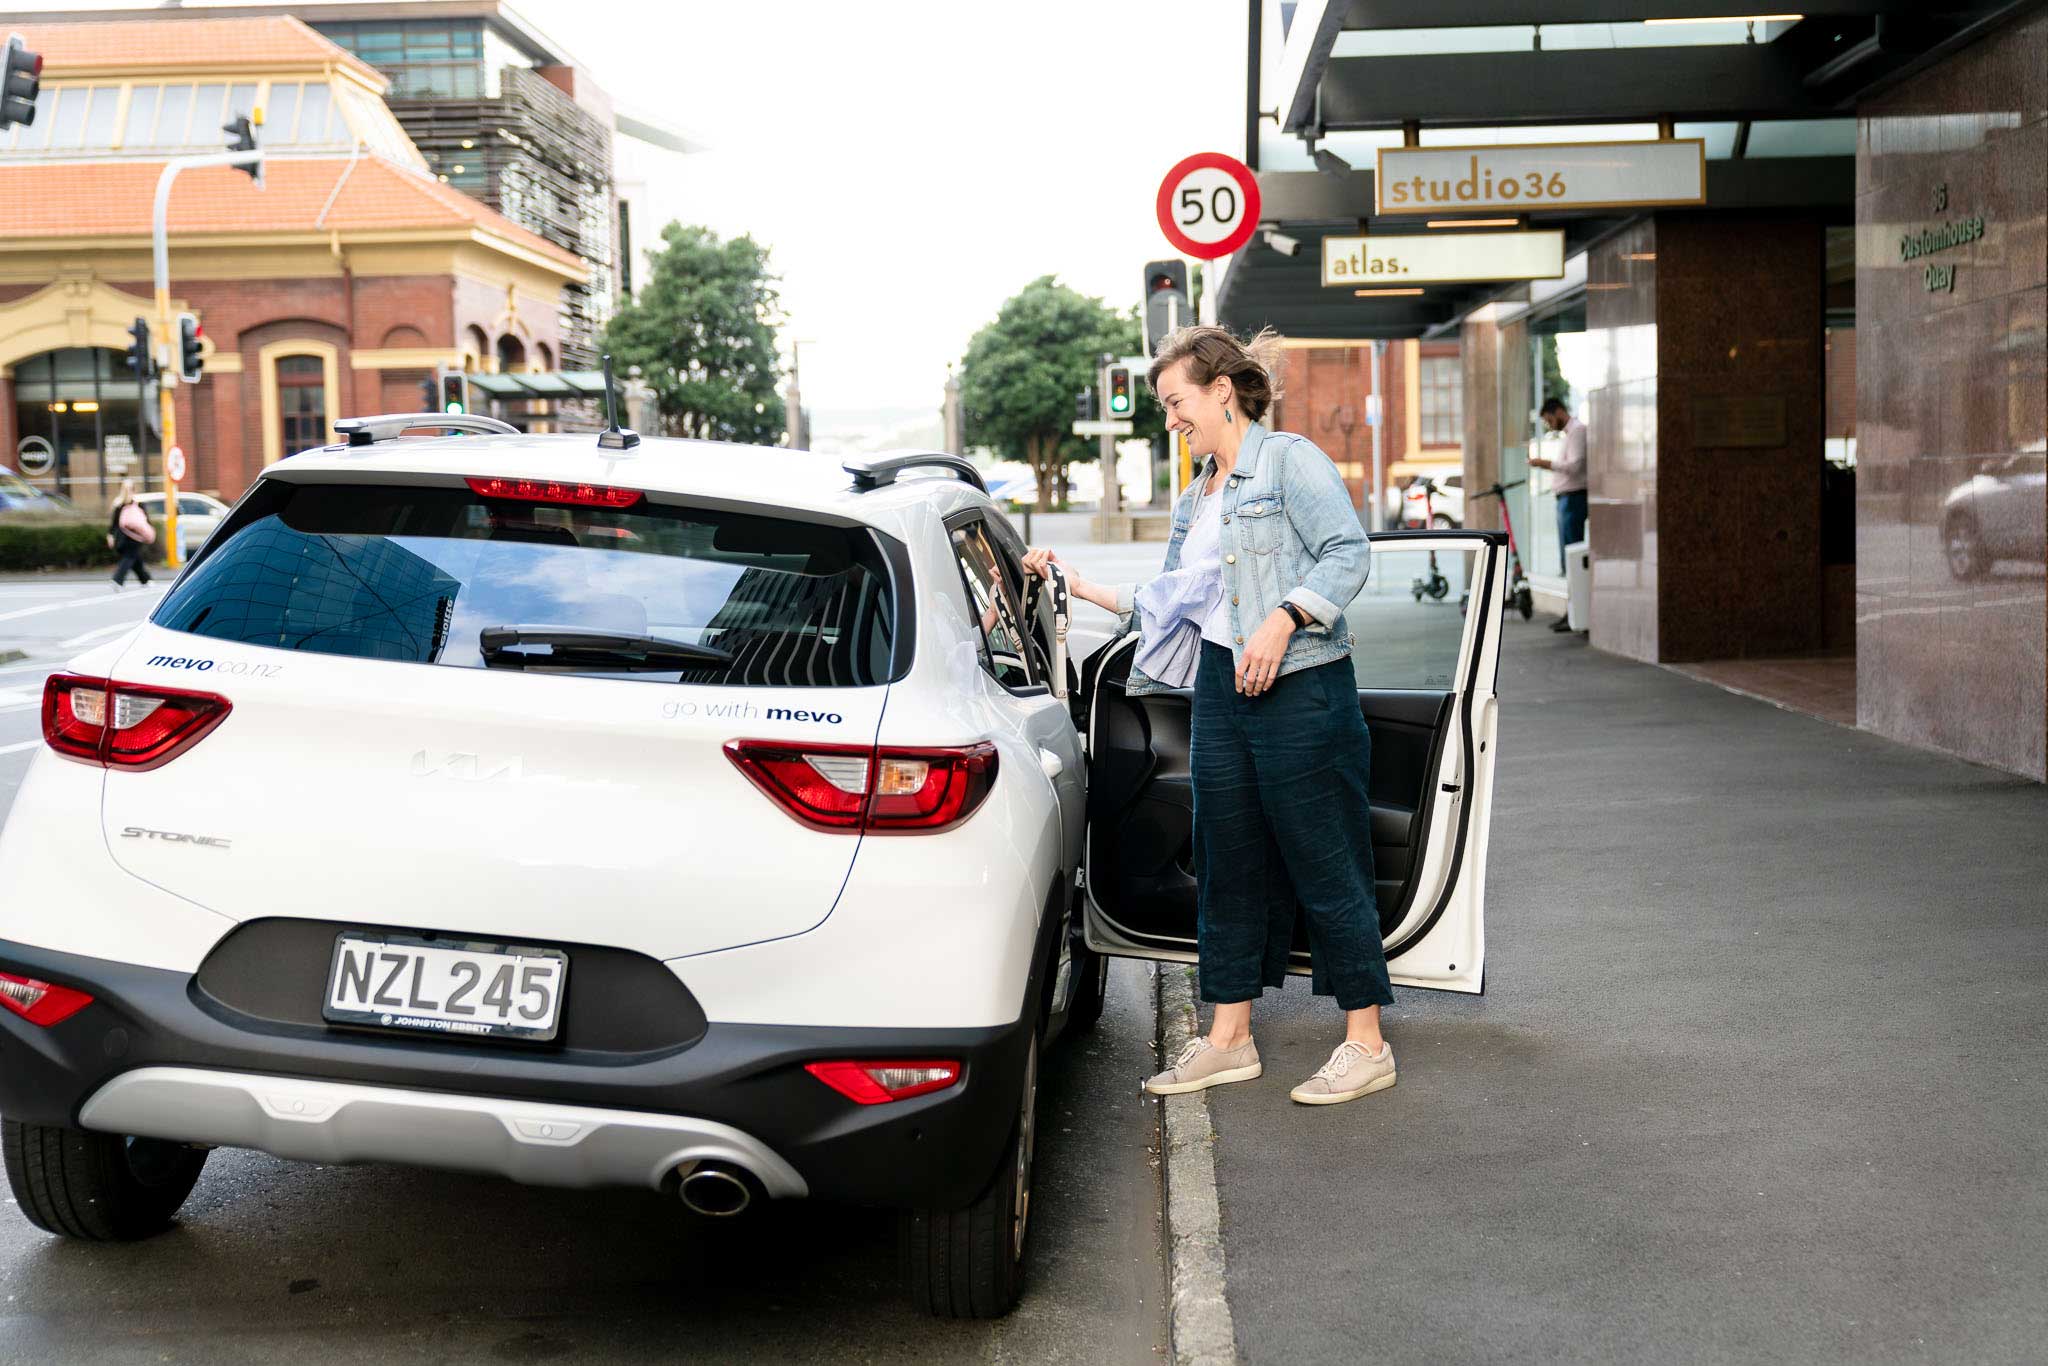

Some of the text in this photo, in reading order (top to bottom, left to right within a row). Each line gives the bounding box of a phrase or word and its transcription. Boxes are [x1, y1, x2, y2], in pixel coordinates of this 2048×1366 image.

[1391, 155, 1567, 203] studio36
[1181, 186, 1236, 226] 50
[1899, 212, 1985, 262] Customhouse
[1333, 243, 1409, 276] atlas.
[1923, 263, 1956, 294] Quay
[146, 654, 284, 679] mevo.co.nz
[662, 700, 844, 725] go with mevo
[120, 826, 232, 848] STONIC
[337, 949, 553, 1021] NZL245
[394, 1016, 451, 1032] JOHNSTON
